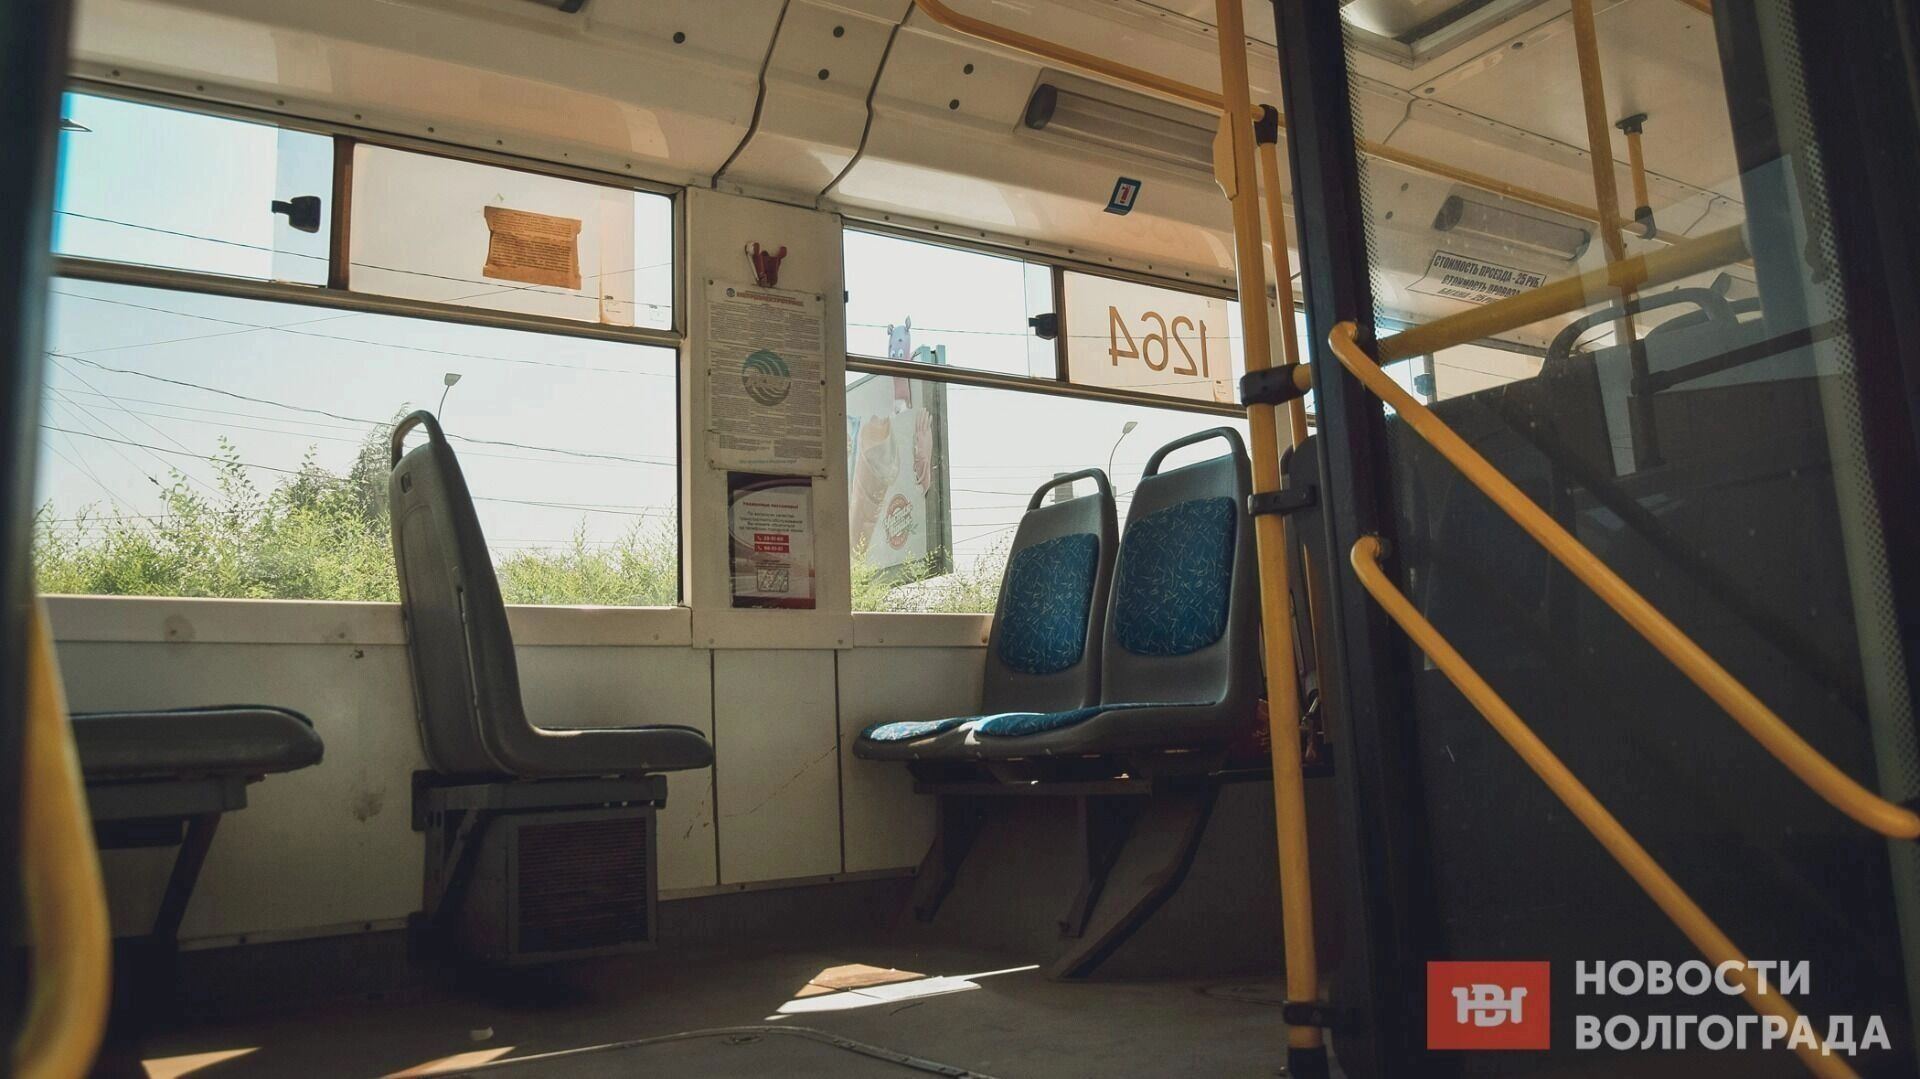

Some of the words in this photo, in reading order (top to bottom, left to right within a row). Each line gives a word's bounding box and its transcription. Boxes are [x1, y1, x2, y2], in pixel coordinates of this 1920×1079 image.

[1434, 255, 1479, 275] СТОИМОСТЬ
[1480, 265, 1512, 283] ПРОЕЗДА
[1515, 272, 1527, 286] 25
[1442, 274, 1487, 292] СТОИМОСТЬ
